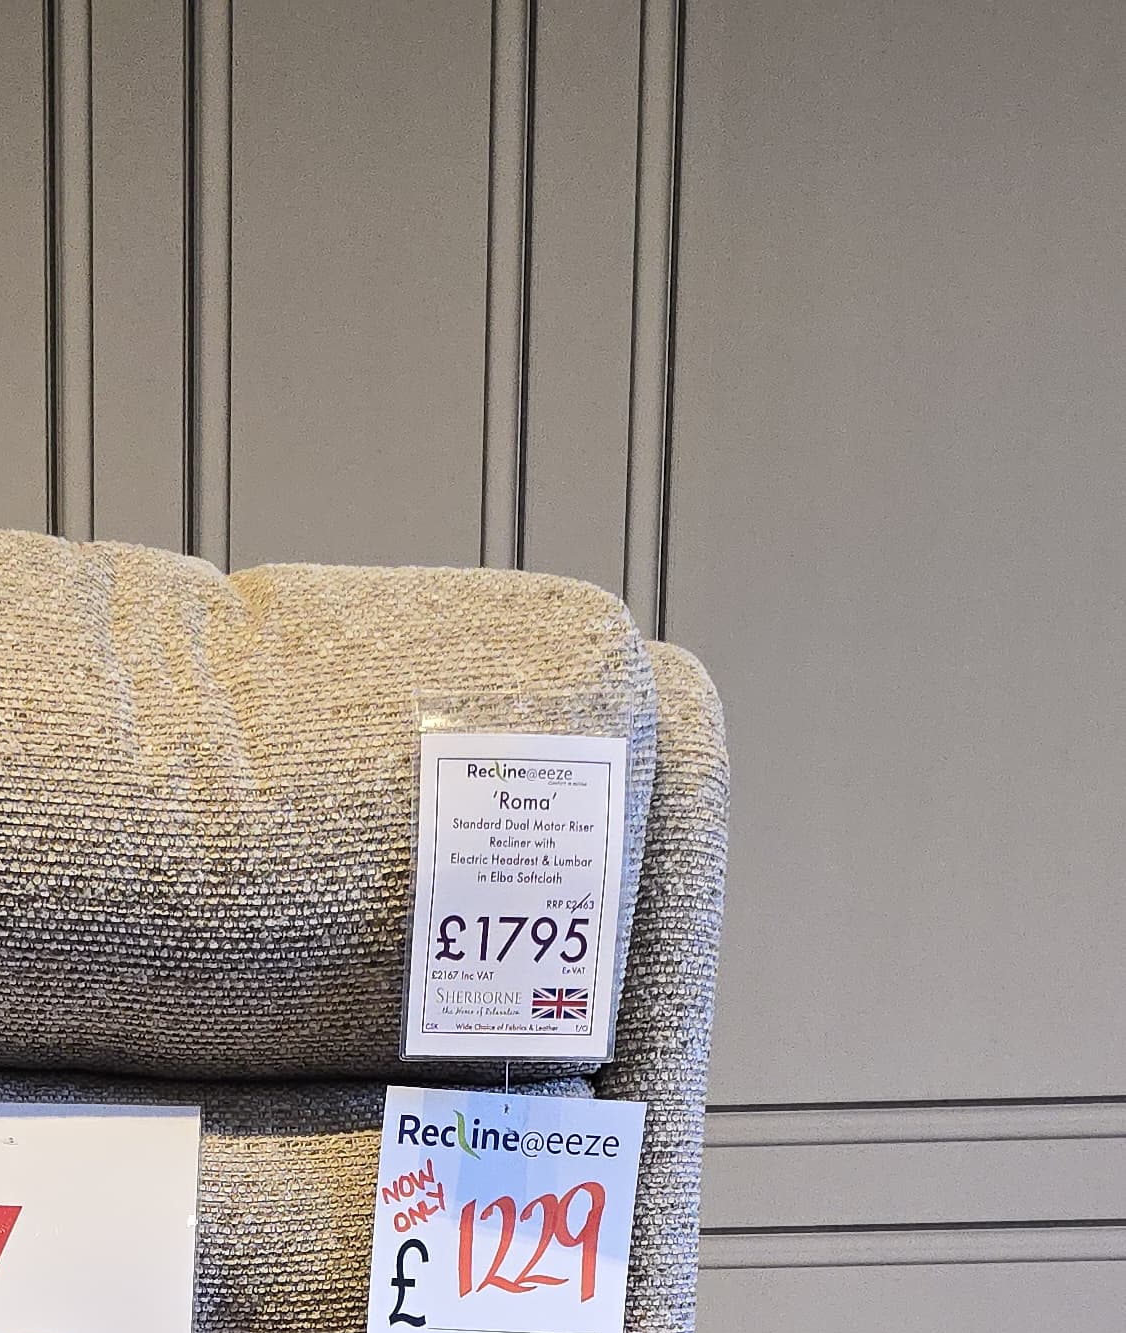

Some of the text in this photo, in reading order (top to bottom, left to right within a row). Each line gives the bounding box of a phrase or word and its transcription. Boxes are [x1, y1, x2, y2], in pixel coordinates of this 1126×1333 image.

[452, 818, 594, 833] Standard Dual Motor Riser
[489, 837, 555, 849] Recliner with
[450, 853, 592, 867] Electric Headrest & Lumbar
[477, 871, 562, 884] in Elba Softcloth
[546, 900, 563, 909] RRP
[435, 914, 589, 963] £1795
[431, 970, 494, 980] £2167 Inc VAT
[572, 967, 586, 975] VAT
[381, 1158, 435, 1205] NOW
[394, 1182, 446, 1233] ONLY
[458, 1181, 606, 1303] 1229
